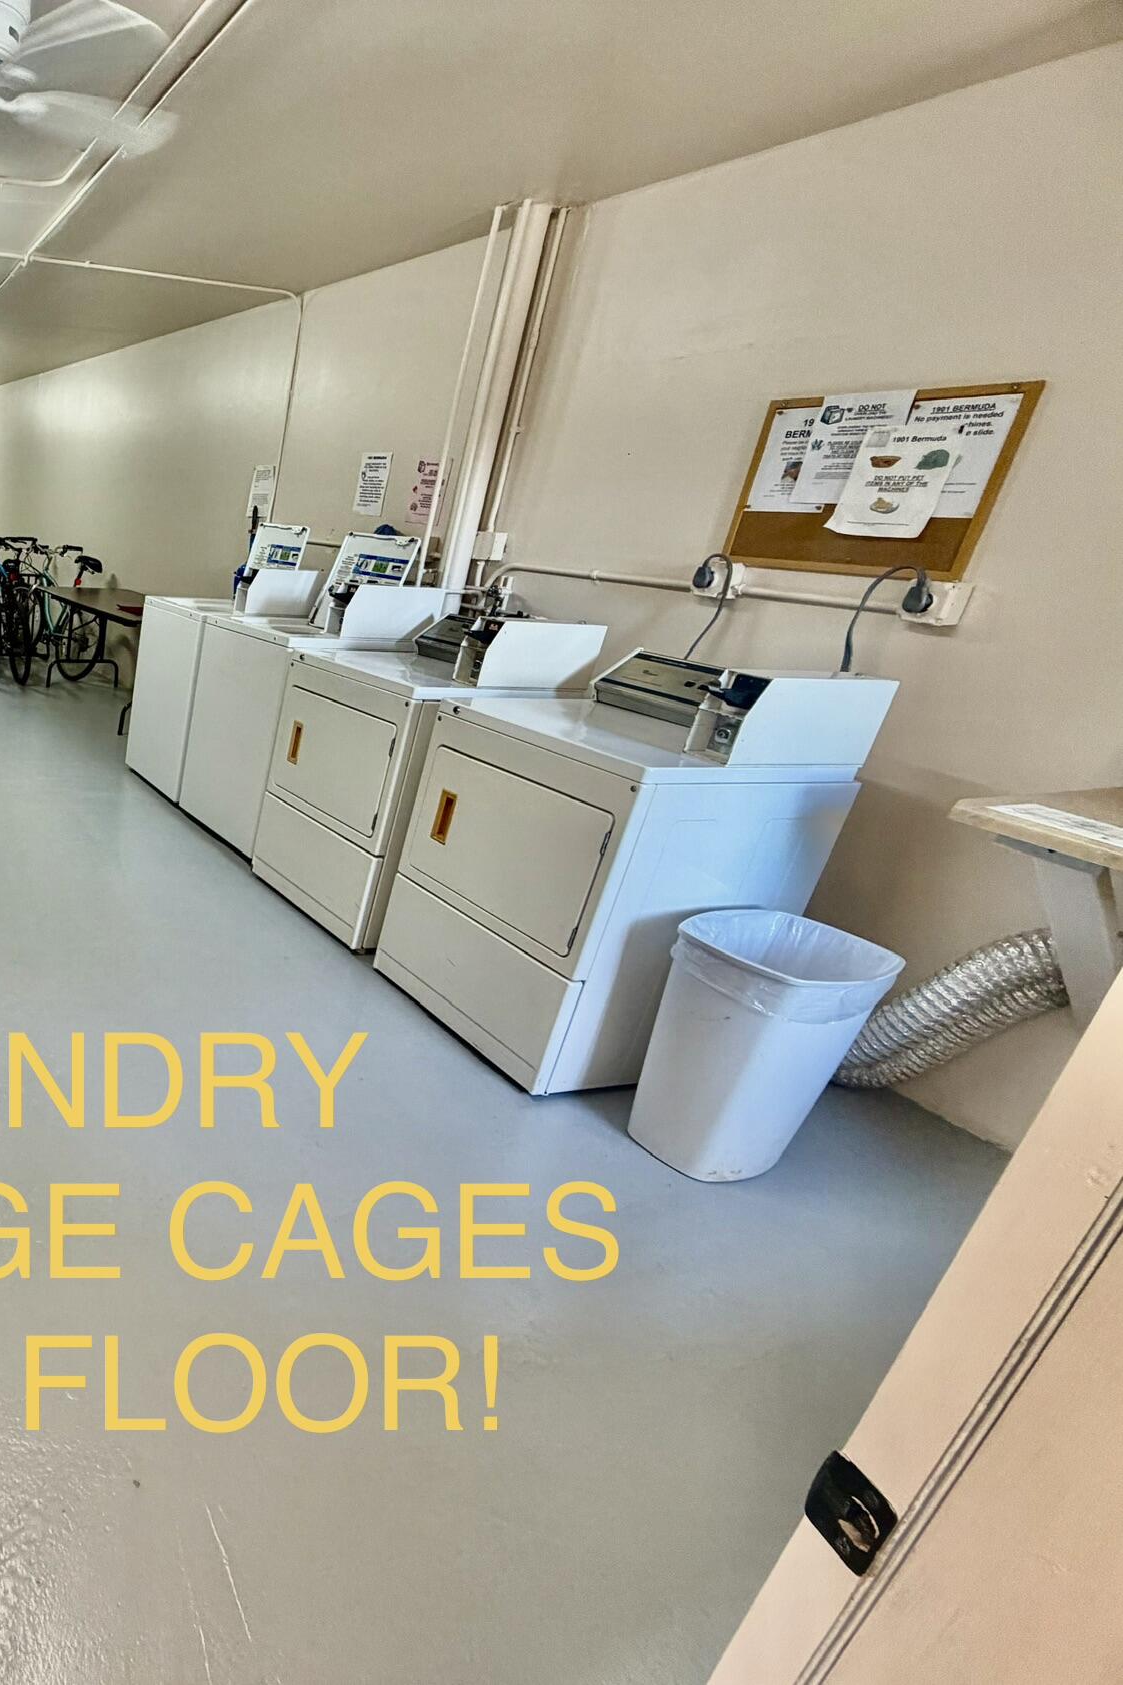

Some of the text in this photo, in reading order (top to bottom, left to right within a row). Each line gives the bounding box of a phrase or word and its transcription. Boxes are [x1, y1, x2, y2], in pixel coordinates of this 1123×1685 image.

[858, 403, 887, 412] DO NOT
[952, 403, 996, 413] BERMUDA
[926, 414, 962, 424] payment
[972, 411, 1004, 419] needed
[803, 418, 815, 427] 19
[911, 435, 947, 443] Bermuda
